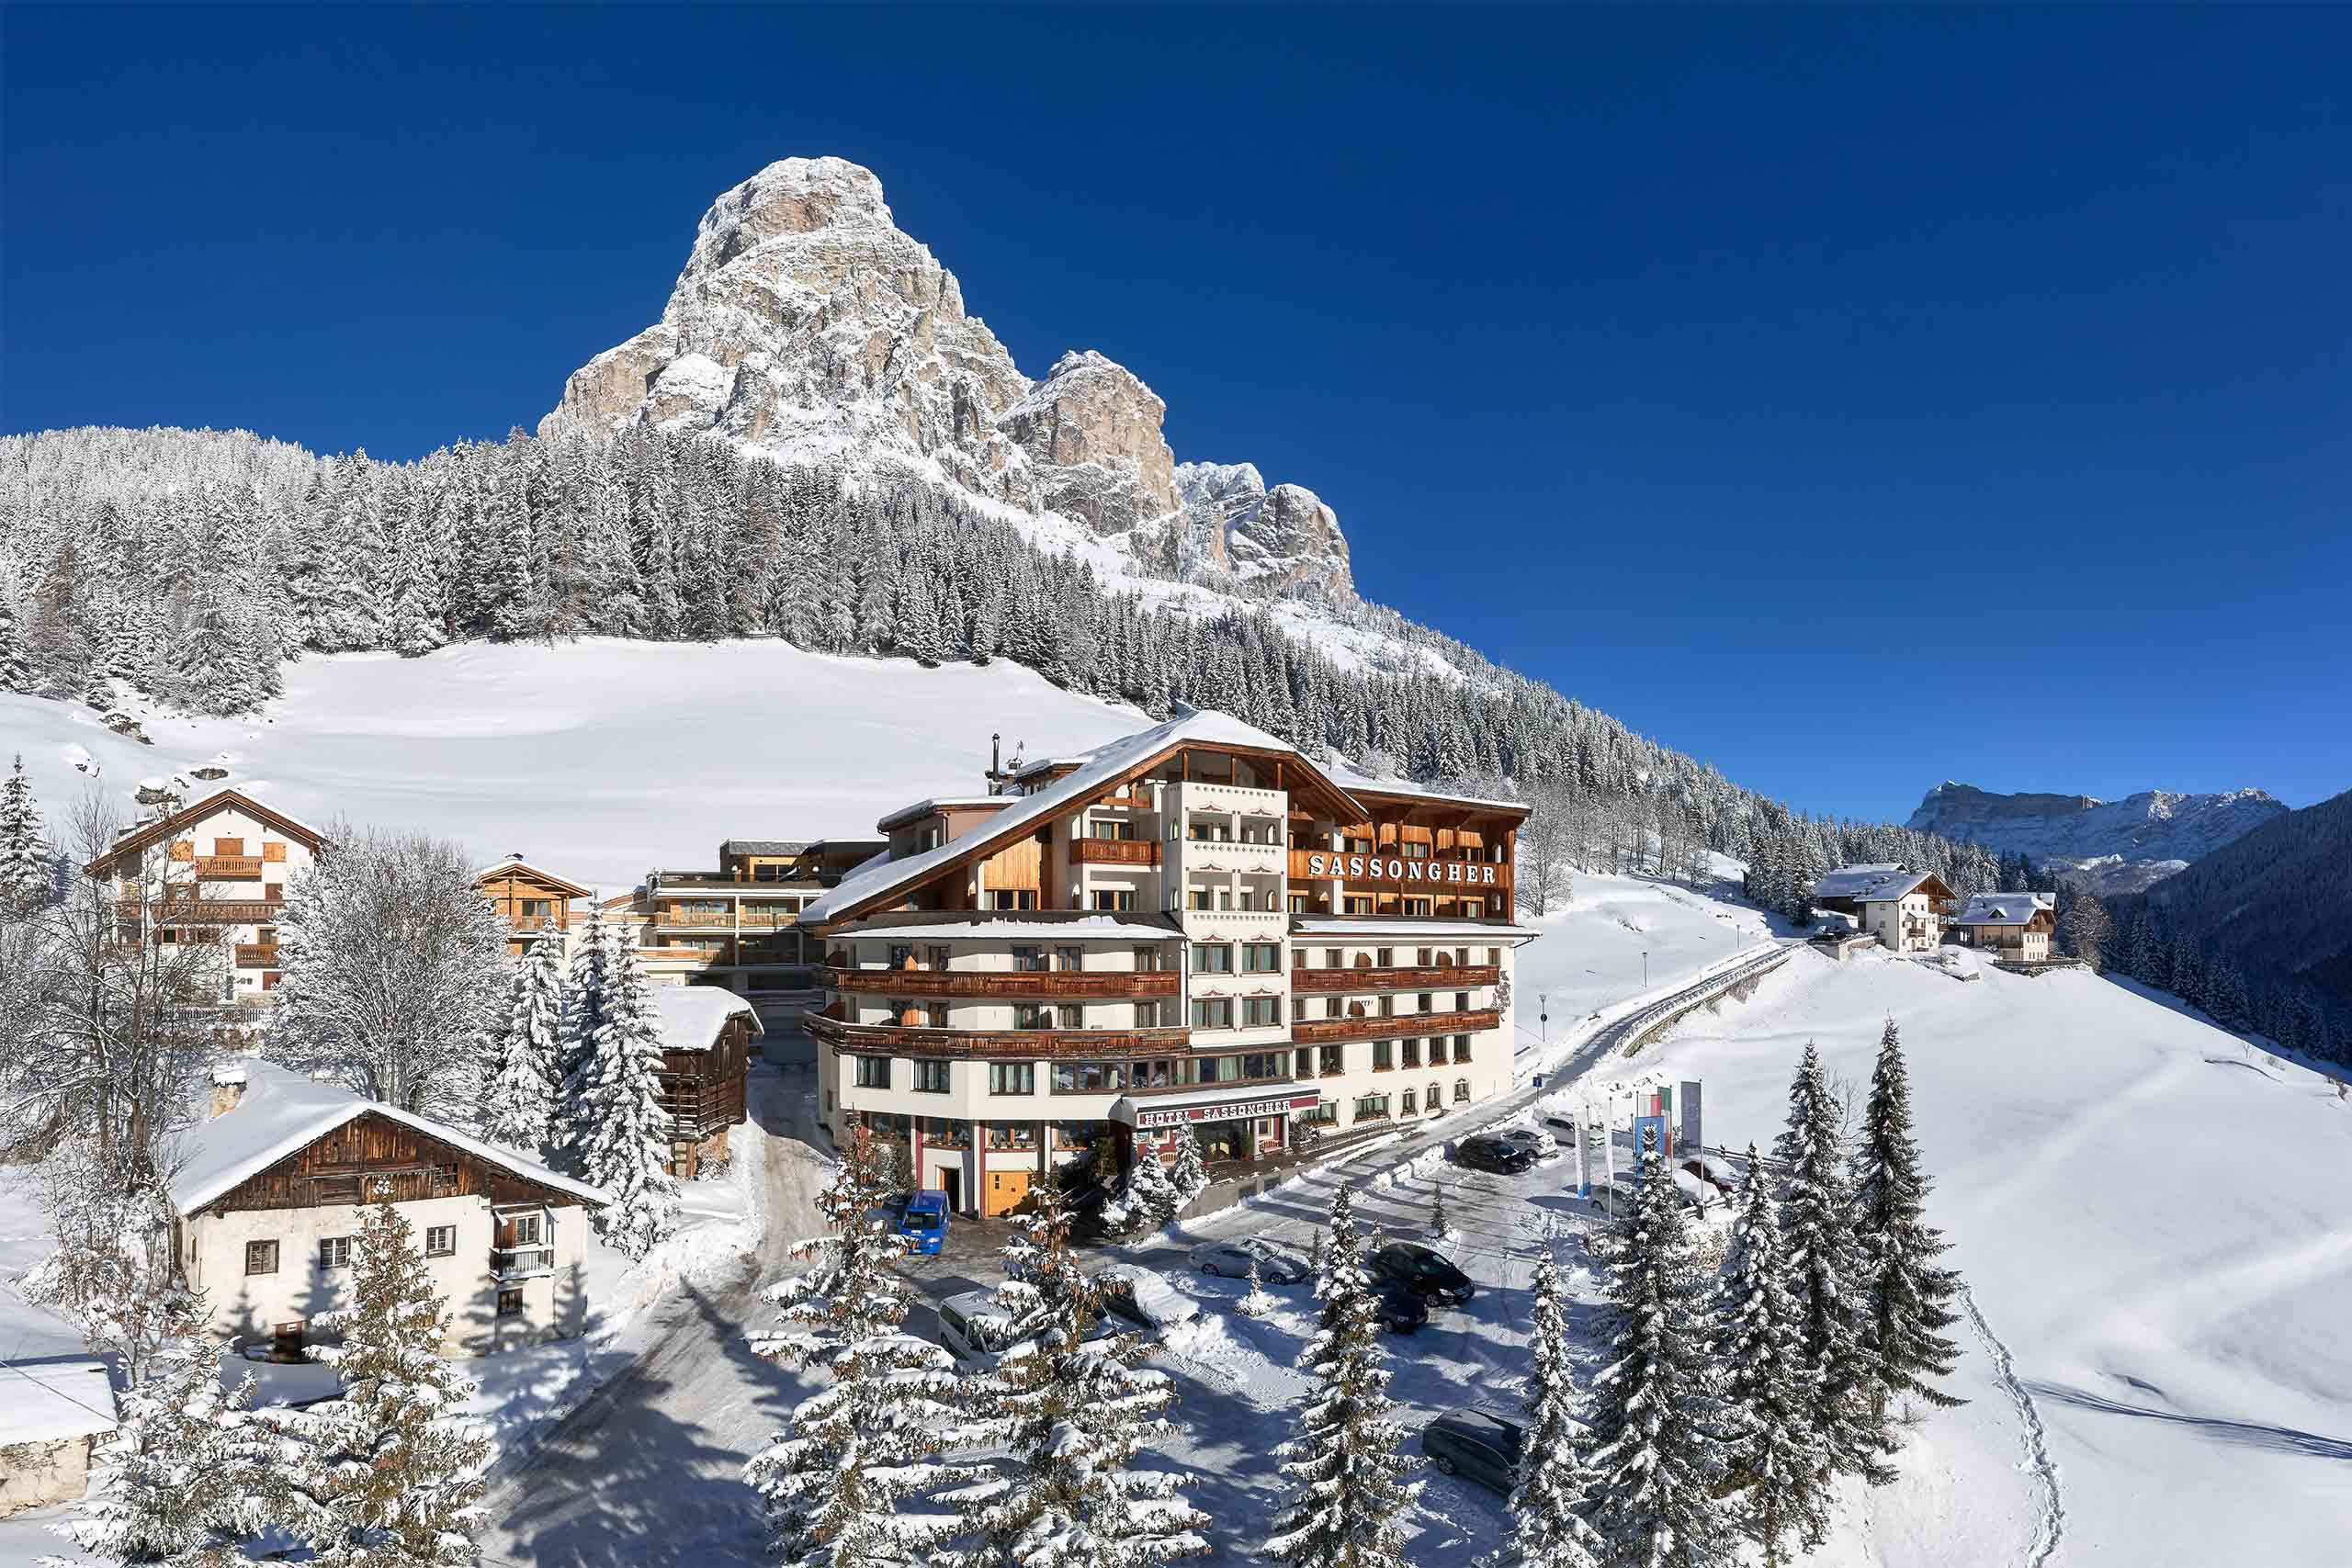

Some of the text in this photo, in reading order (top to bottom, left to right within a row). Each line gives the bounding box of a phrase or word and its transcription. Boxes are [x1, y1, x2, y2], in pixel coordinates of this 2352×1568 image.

[1309, 854, 1496, 884] SASSONGHER
[1145, 1100, 1290, 1125] HOTEL SASSONGHER
